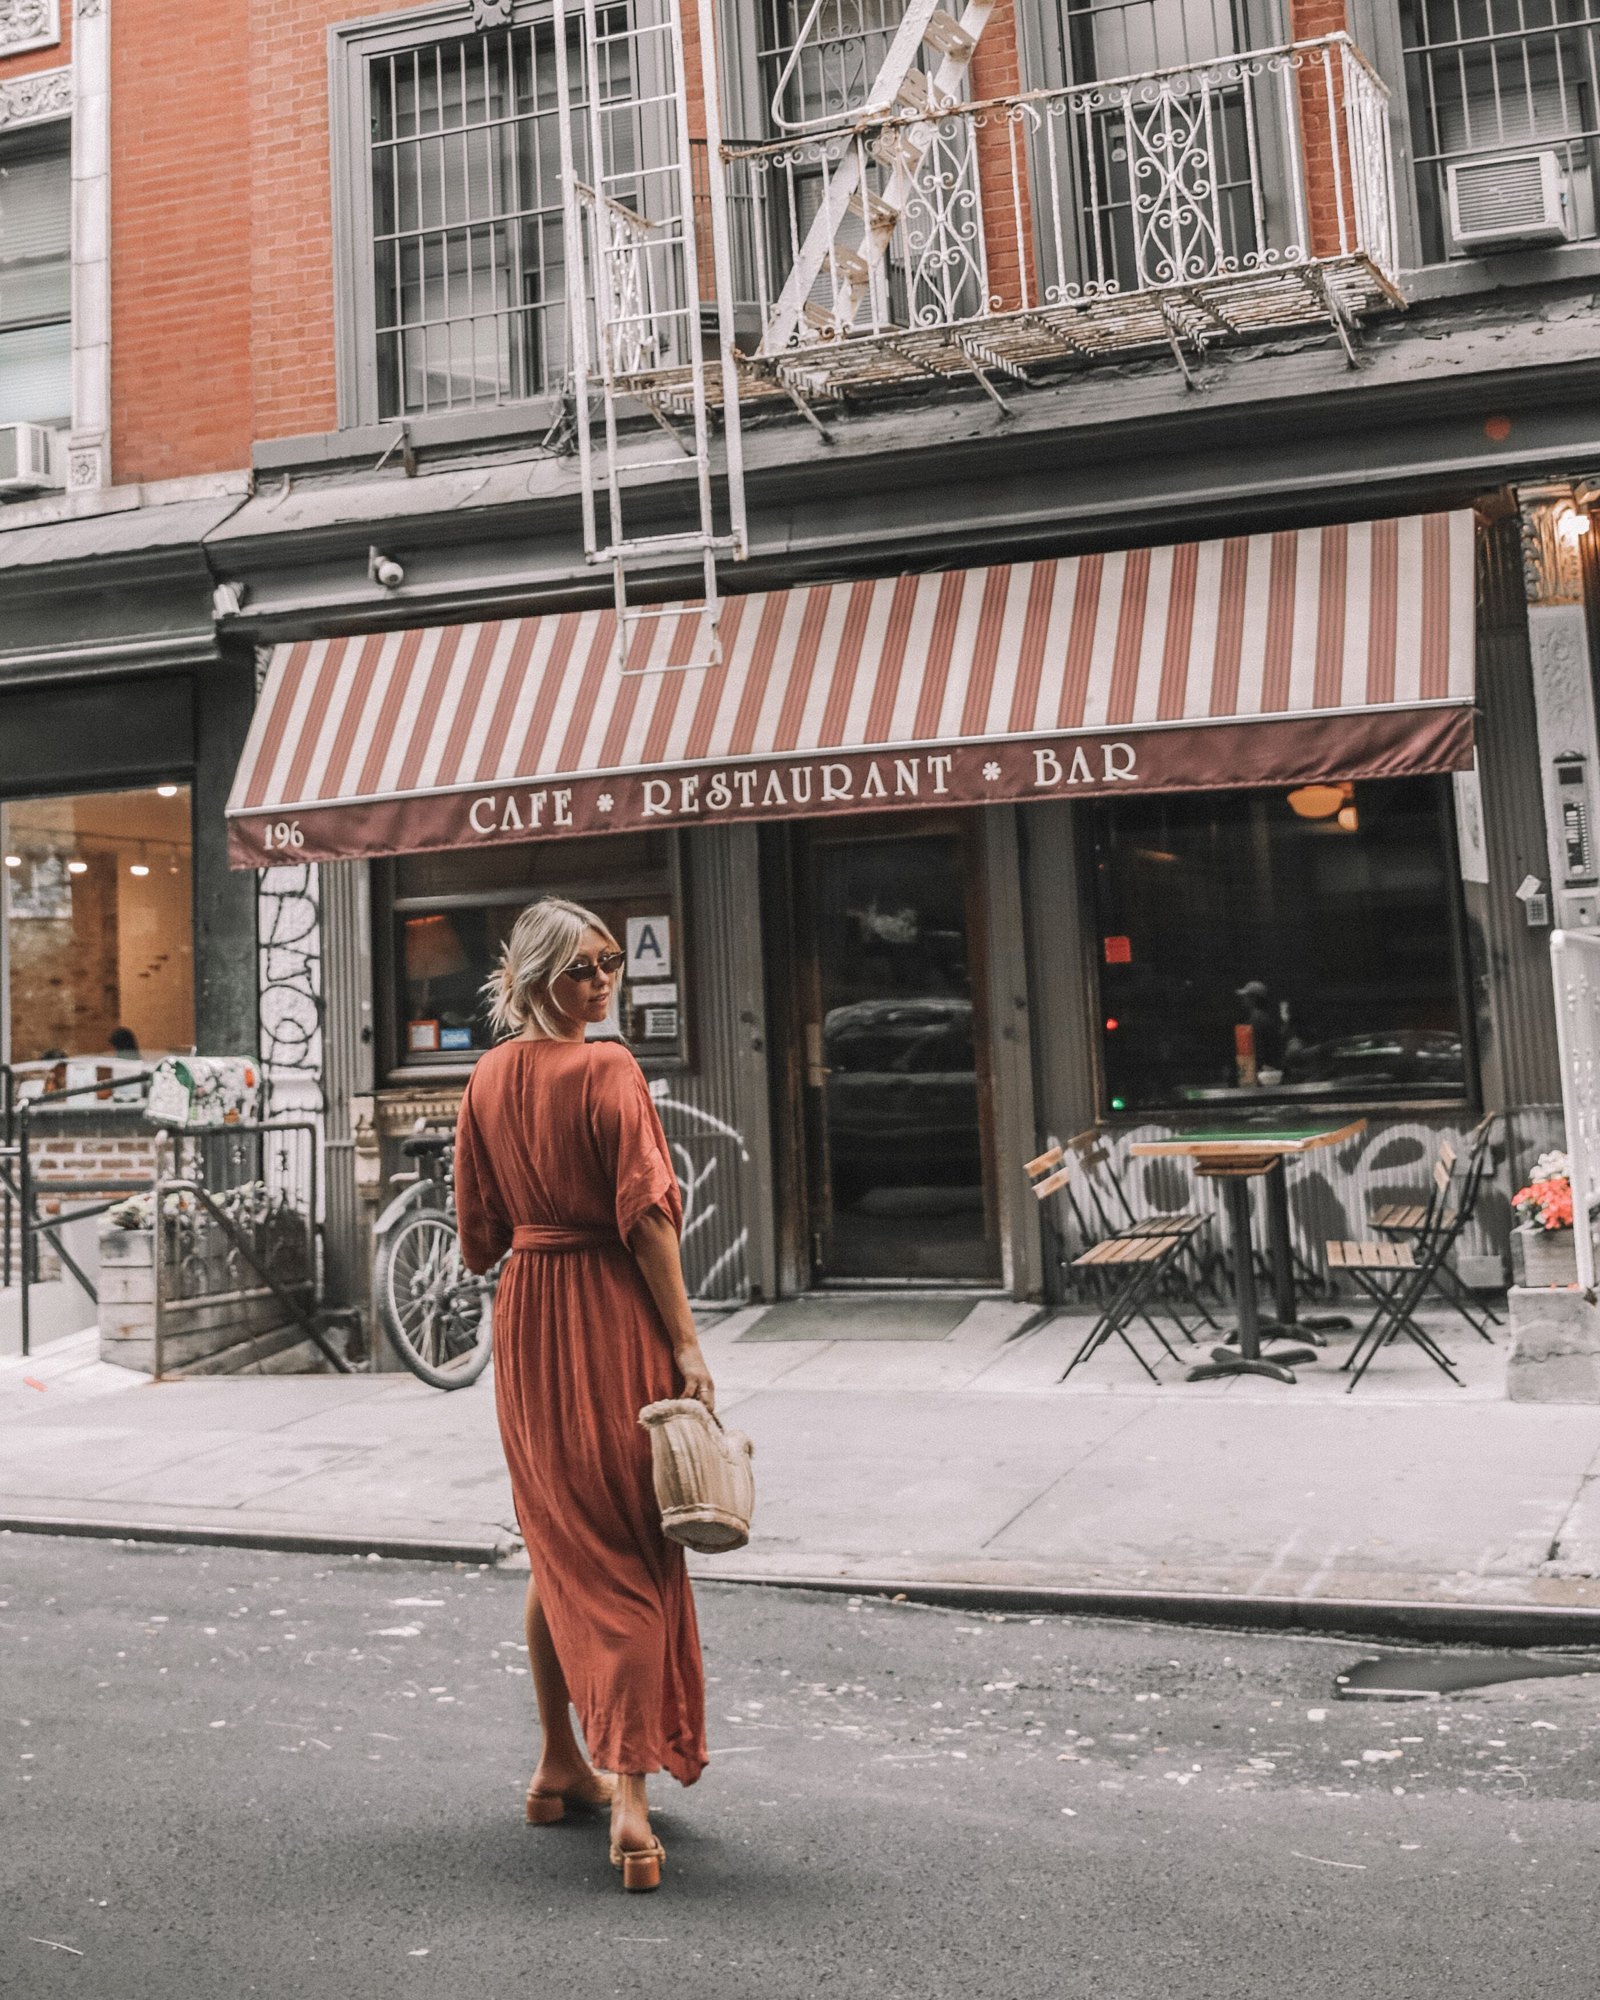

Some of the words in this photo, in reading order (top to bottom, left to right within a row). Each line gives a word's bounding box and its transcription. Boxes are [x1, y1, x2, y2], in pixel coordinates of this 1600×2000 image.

[469, 788, 573, 834] CAFE
[641, 754, 952, 817] RESTAURANT
[1032, 742, 1138, 787] BAR
[263, 820, 304, 850] 196
[634, 924, 662, 960] A
